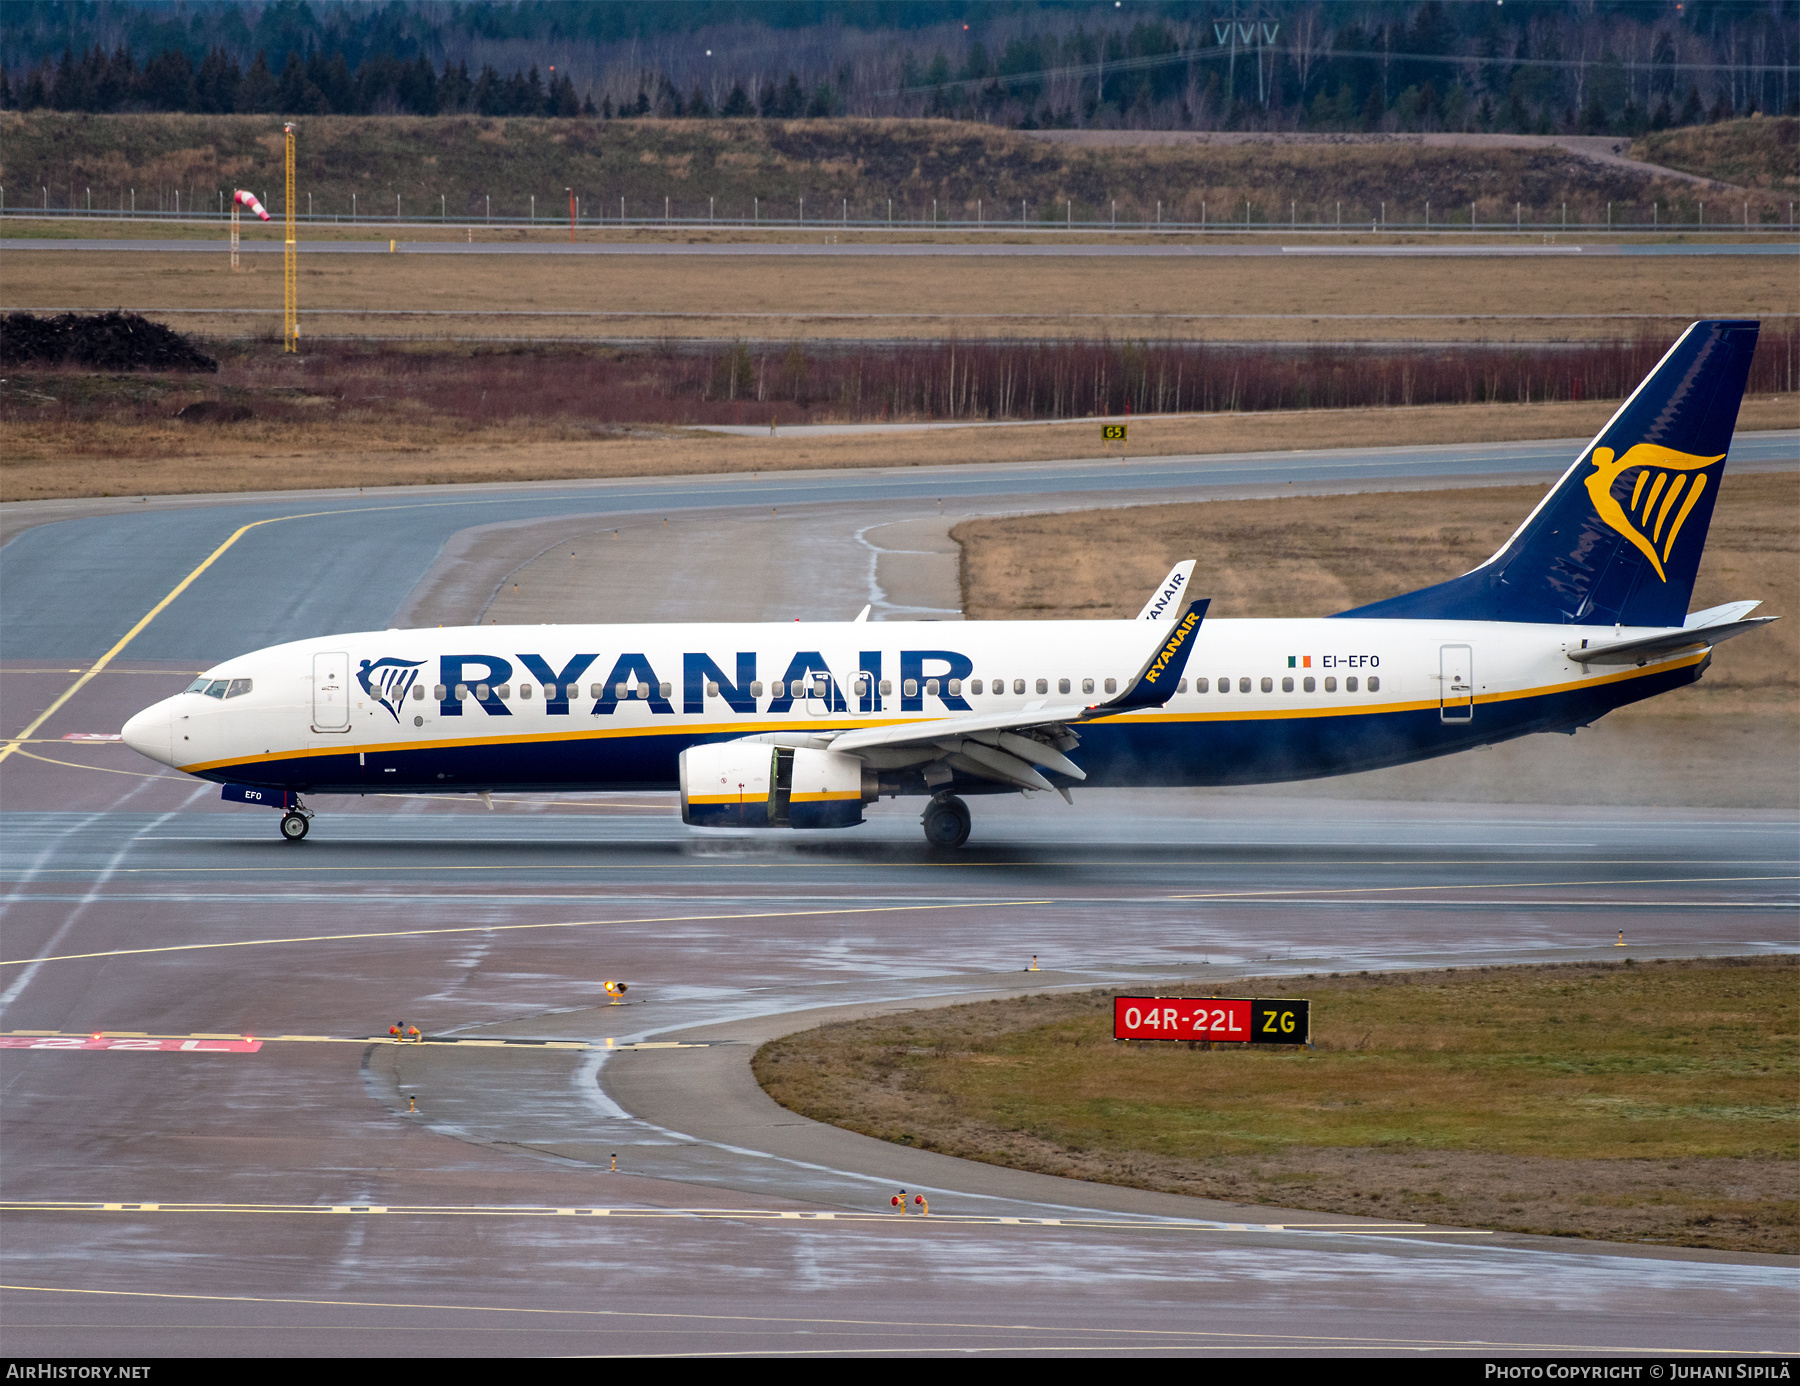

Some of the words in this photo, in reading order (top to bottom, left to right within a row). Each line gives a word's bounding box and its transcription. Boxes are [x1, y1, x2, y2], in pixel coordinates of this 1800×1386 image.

[1106, 427, 1122, 438] G5
[1146, 573, 1186, 620] ANAIR
[1145, 612, 1200, 684] RYANAIR
[1322, 655, 1380, 668] EI-EFO
[439, 650, 973, 716] RYANAIR
[244, 790, 262, 800] EFO
[1124, 1007, 1242, 1032] 04R-22L
[1262, 1010, 1296, 1033] ZG
[0, 1038, 230, 1051] 22L
